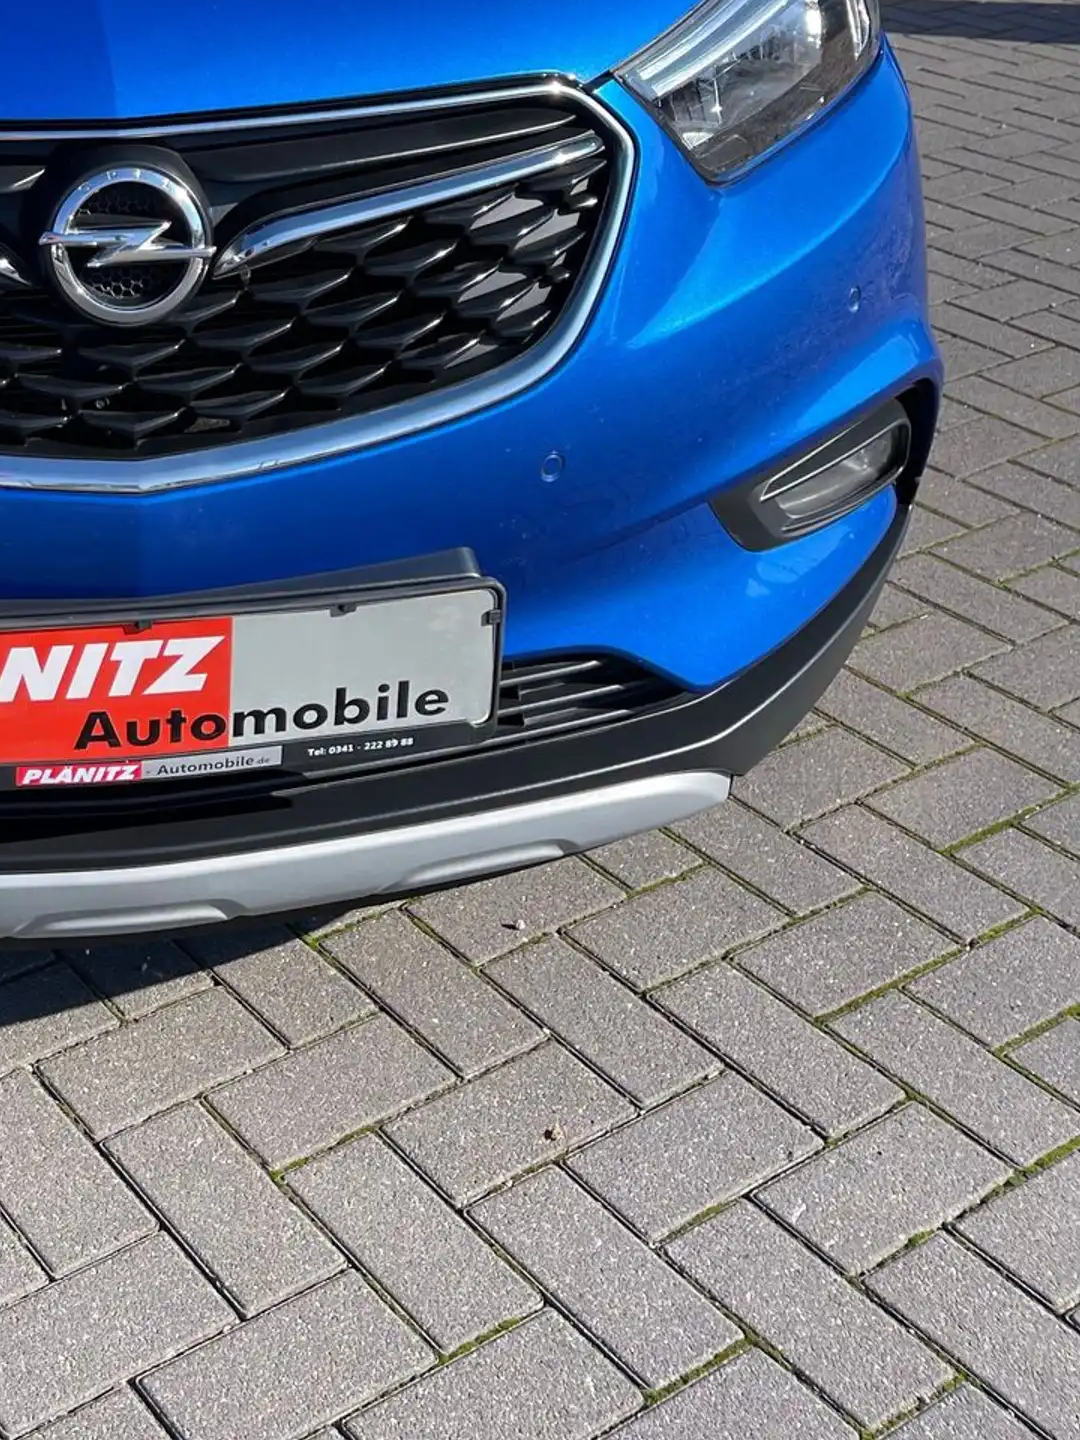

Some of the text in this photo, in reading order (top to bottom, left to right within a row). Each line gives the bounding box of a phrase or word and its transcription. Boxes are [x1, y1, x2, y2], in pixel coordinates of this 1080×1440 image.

[73, 680, 450, 752] Automobile
[328, 744, 354, 755] 0341
[364, 741, 383, 750] 222
[22, 763, 139, 785] PLÄNITZ
